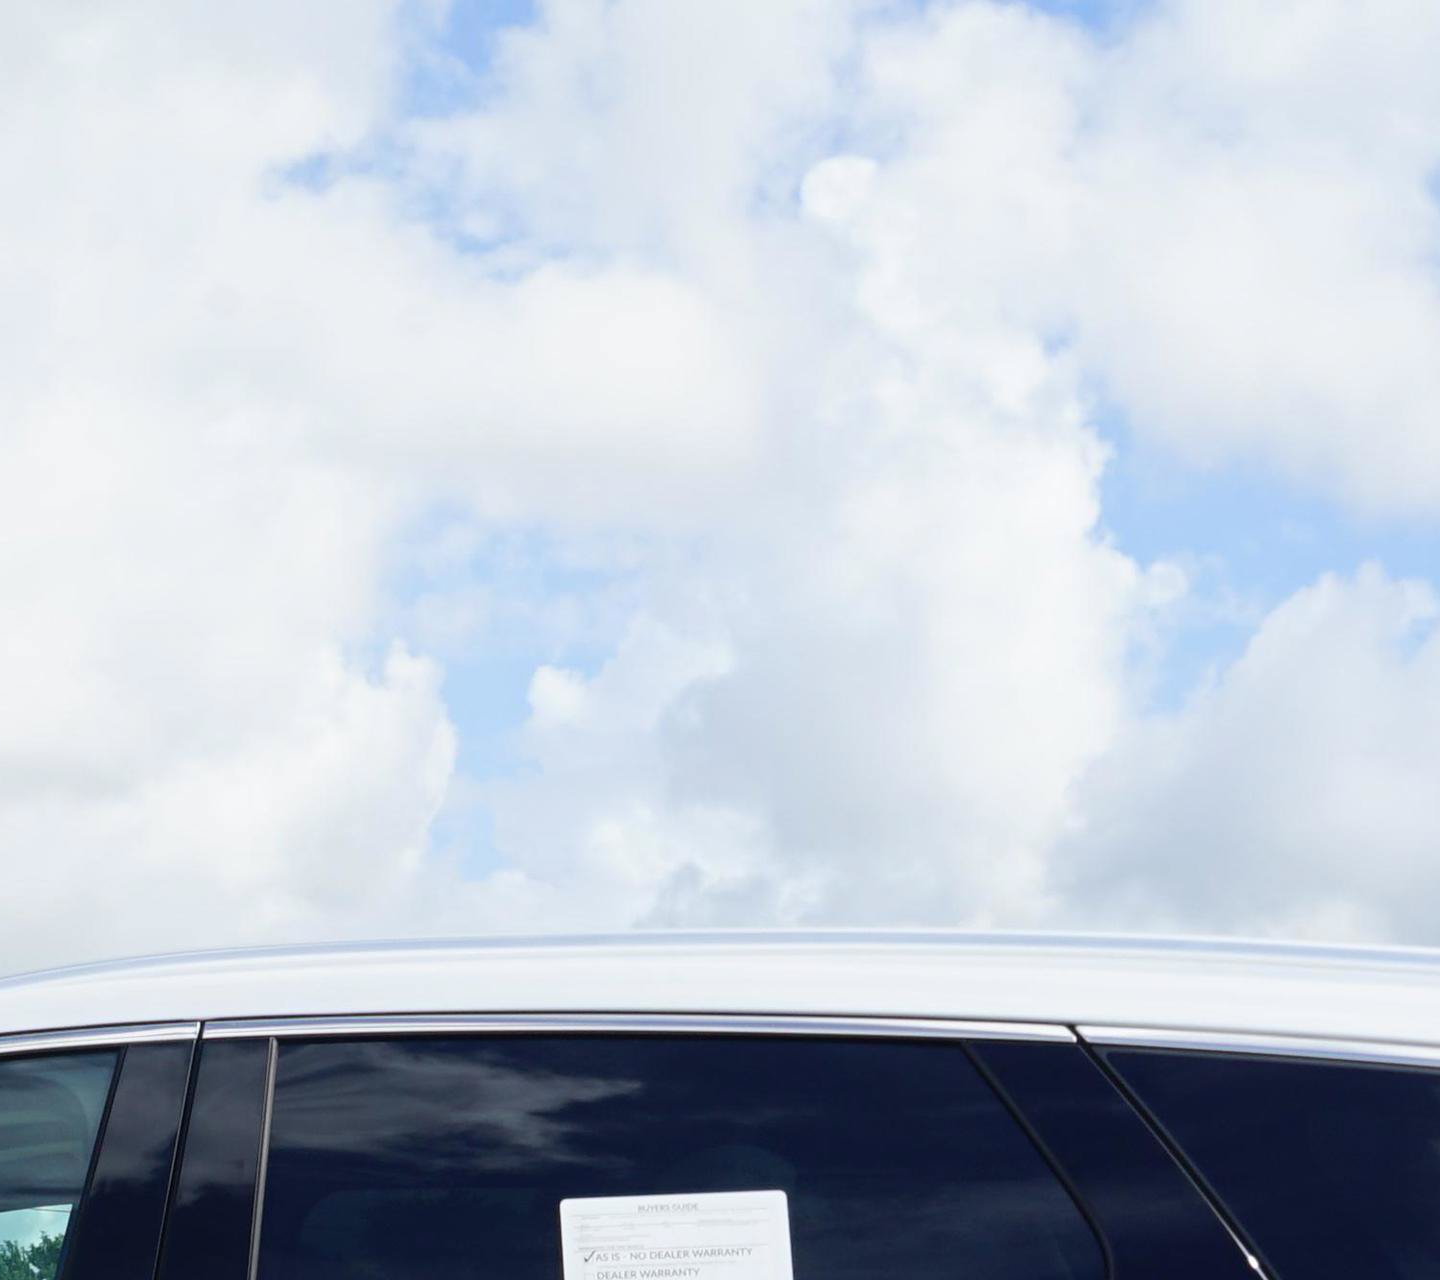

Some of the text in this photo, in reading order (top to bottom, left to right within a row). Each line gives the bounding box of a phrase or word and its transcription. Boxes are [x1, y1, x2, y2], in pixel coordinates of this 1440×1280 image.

[595, 1252, 609, 1262] AS
[611, 1252, 621, 1262] IS
[630, 1251, 646, 1261] NO
[649, 1250, 690, 1260] DEALER
[693, 1247, 753, 1258] WARRANTY
[597, 1267, 700, 1280] DEALER WARRANTY
